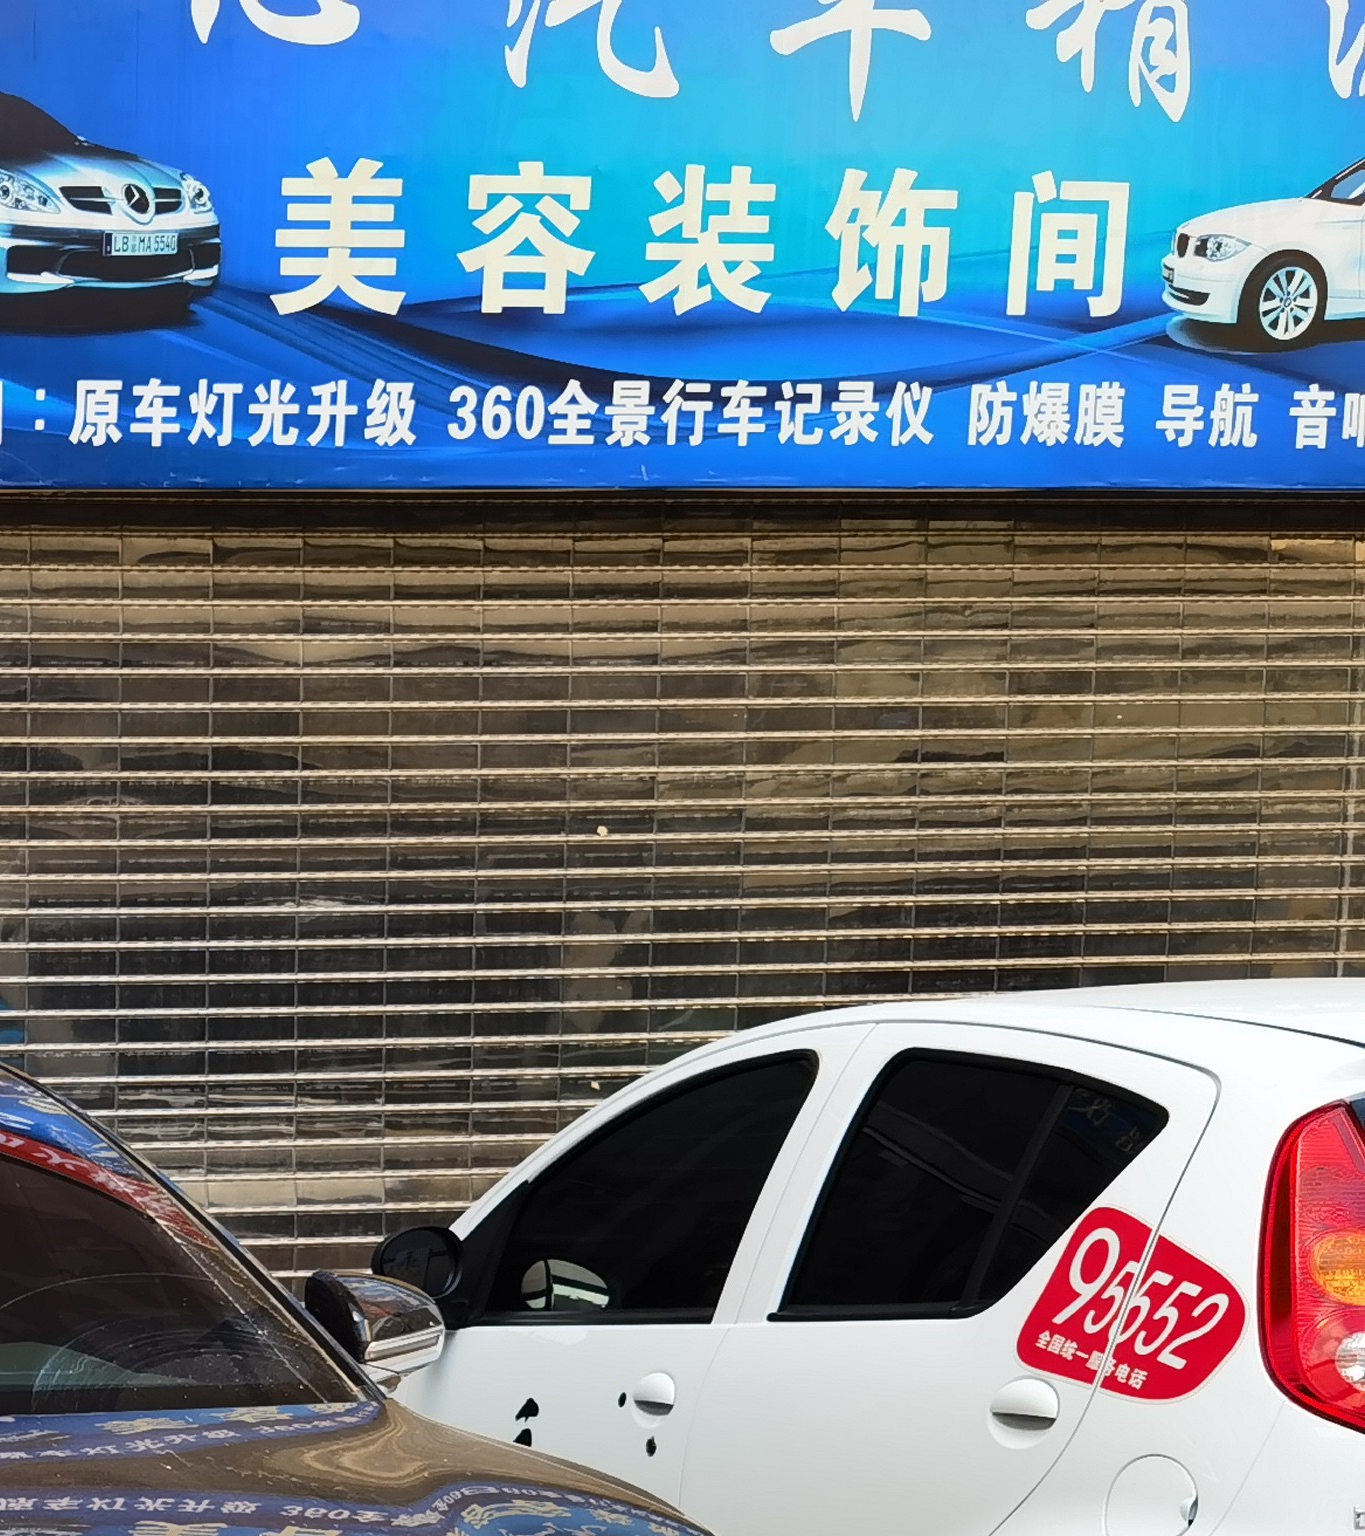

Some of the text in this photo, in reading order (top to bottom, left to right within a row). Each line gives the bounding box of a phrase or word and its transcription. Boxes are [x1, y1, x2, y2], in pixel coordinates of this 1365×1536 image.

[270, 157, 1129, 318] 美容装饰间
[447, 379, 935, 448] 360全景行车记录仪
[967, 382, 1127, 448] 防爆膜
[1155, 385, 1259, 448] 导航
[1052, 1227, 1229, 1370] 95552
